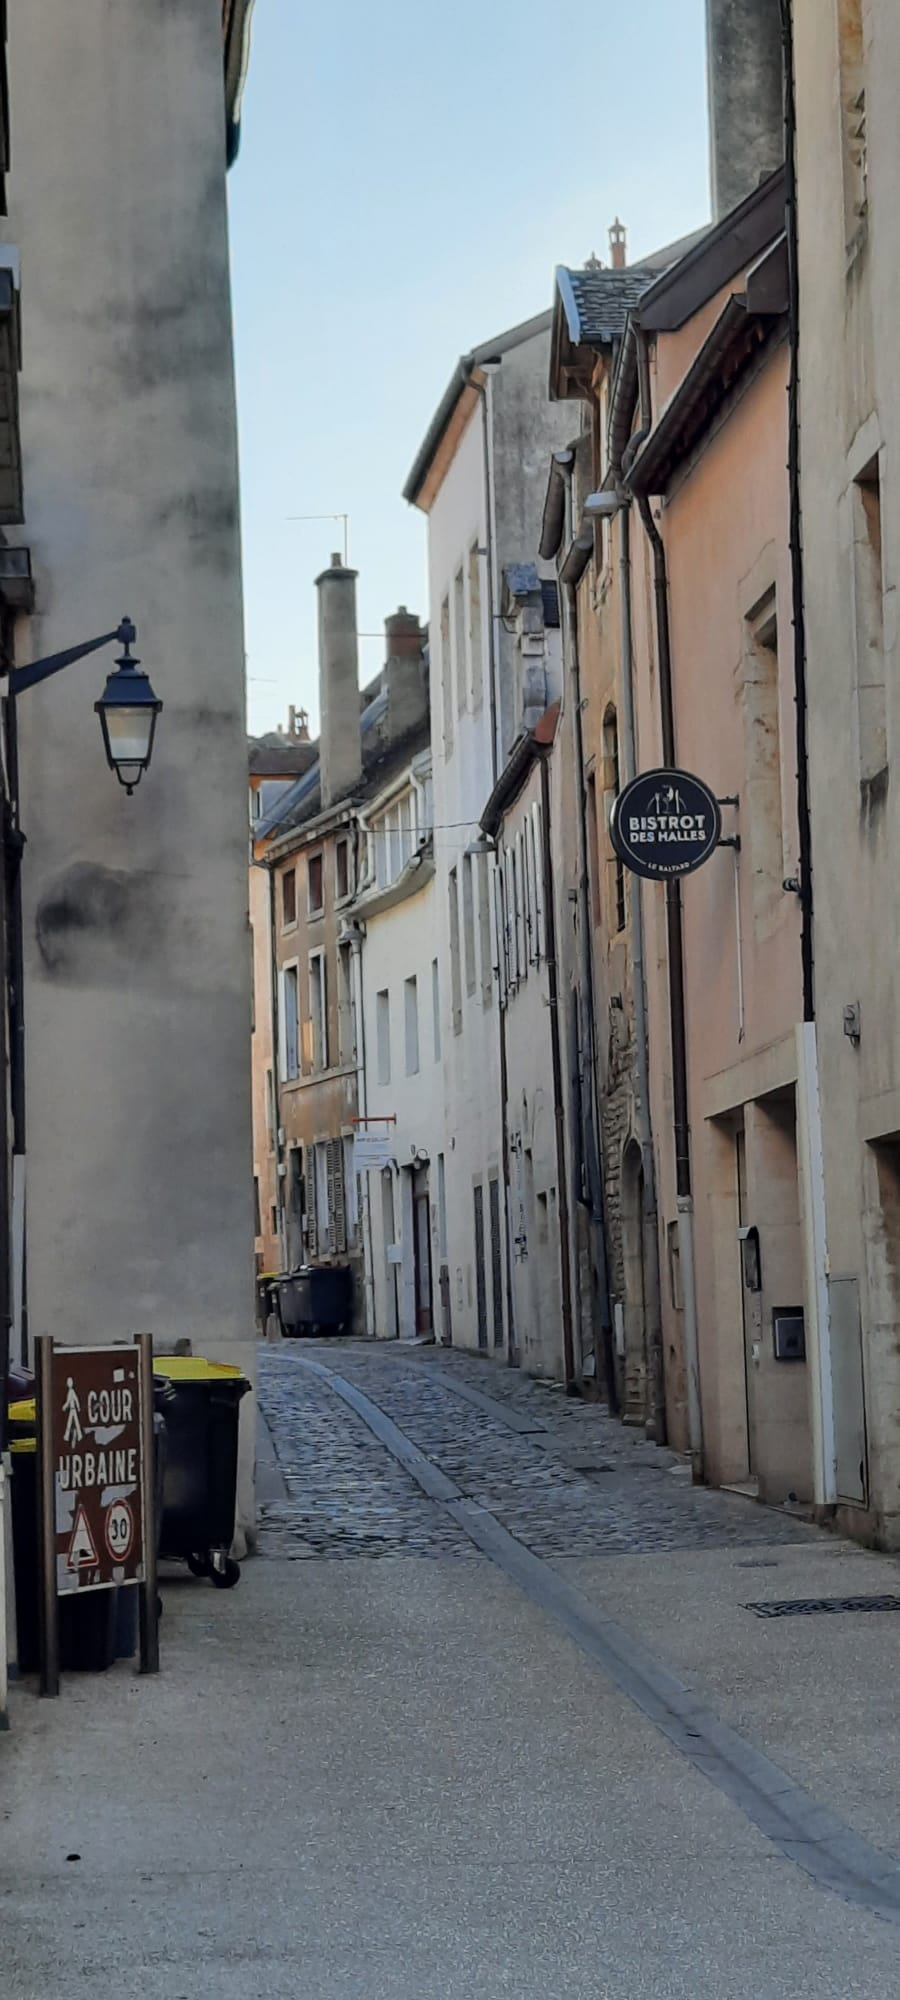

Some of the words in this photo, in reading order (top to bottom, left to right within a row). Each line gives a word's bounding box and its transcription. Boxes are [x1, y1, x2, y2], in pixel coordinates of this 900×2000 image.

[629, 815, 705, 831] BISTROT
[630, 831, 655, 843] DES
[658, 830, 706, 842] HALLES
[648, 861, 657, 870] LE
[87, 1389, 132, 1423] COUR
[59, 1448, 137, 1489] URBAINE
[112, 1518, 127, 1540] 30
